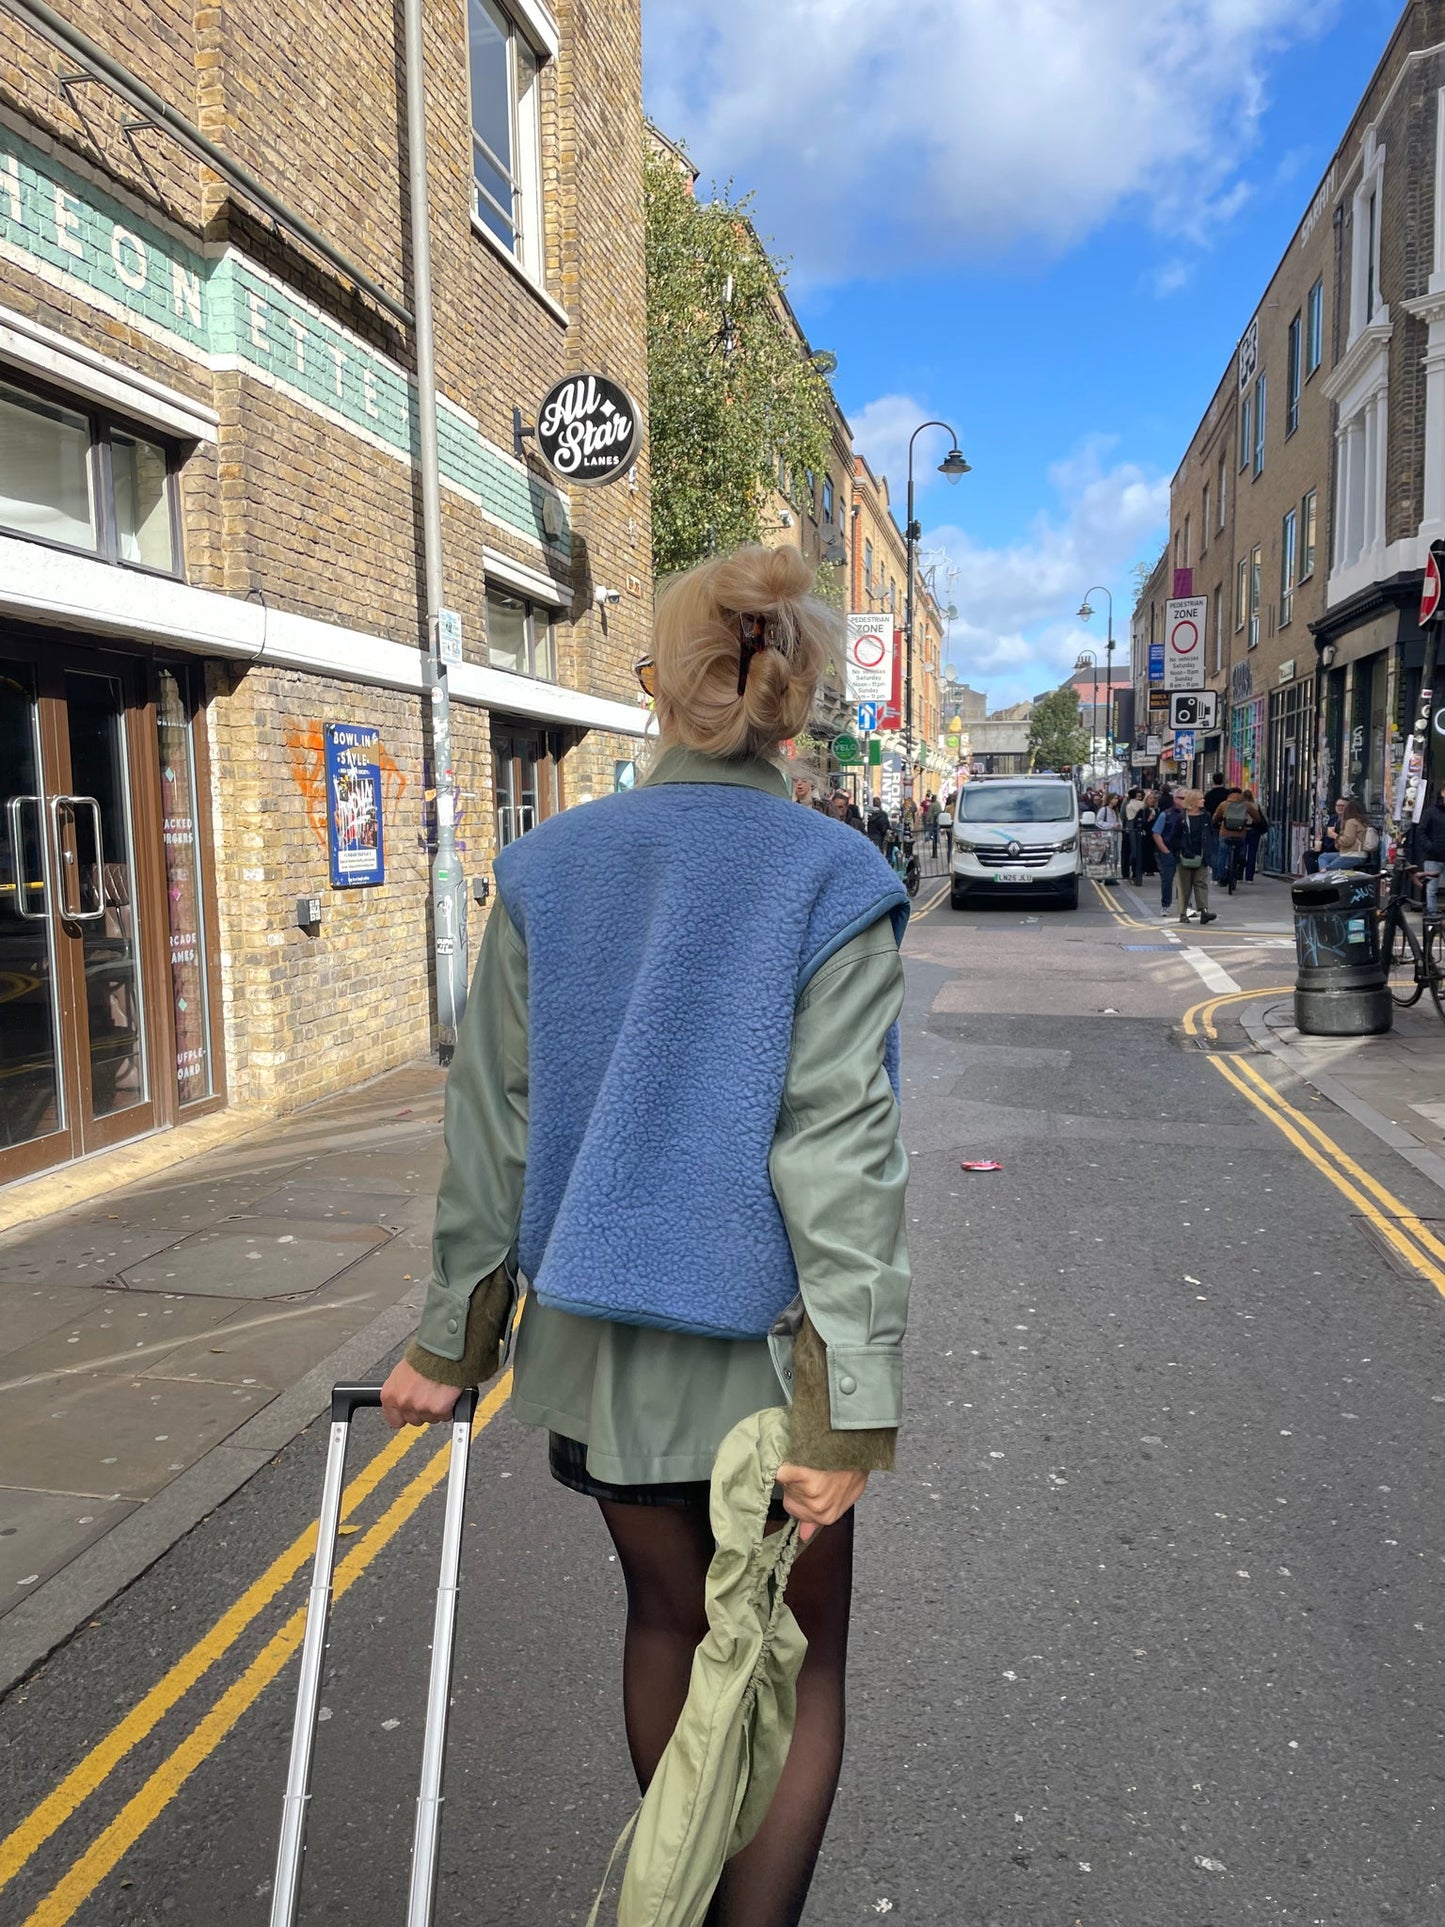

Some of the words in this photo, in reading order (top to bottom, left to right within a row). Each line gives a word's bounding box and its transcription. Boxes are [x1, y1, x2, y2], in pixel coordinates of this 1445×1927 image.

[540, 376, 601, 436] All
[554, 412, 632, 473] Star
[584, 456, 620, 466] LANES
[1169, 599, 1204, 609] PEDESTRIAN
[1174, 608, 1198, 619] ZONE
[856, 624, 884, 633] ZONE
[333, 731, 359, 746] BOWL
[362, 735, 371, 748] IN
[881, 759, 893, 814] VINTA
[891, 772, 901, 824] ROKIT
[163, 818, 193, 829] ACKED
